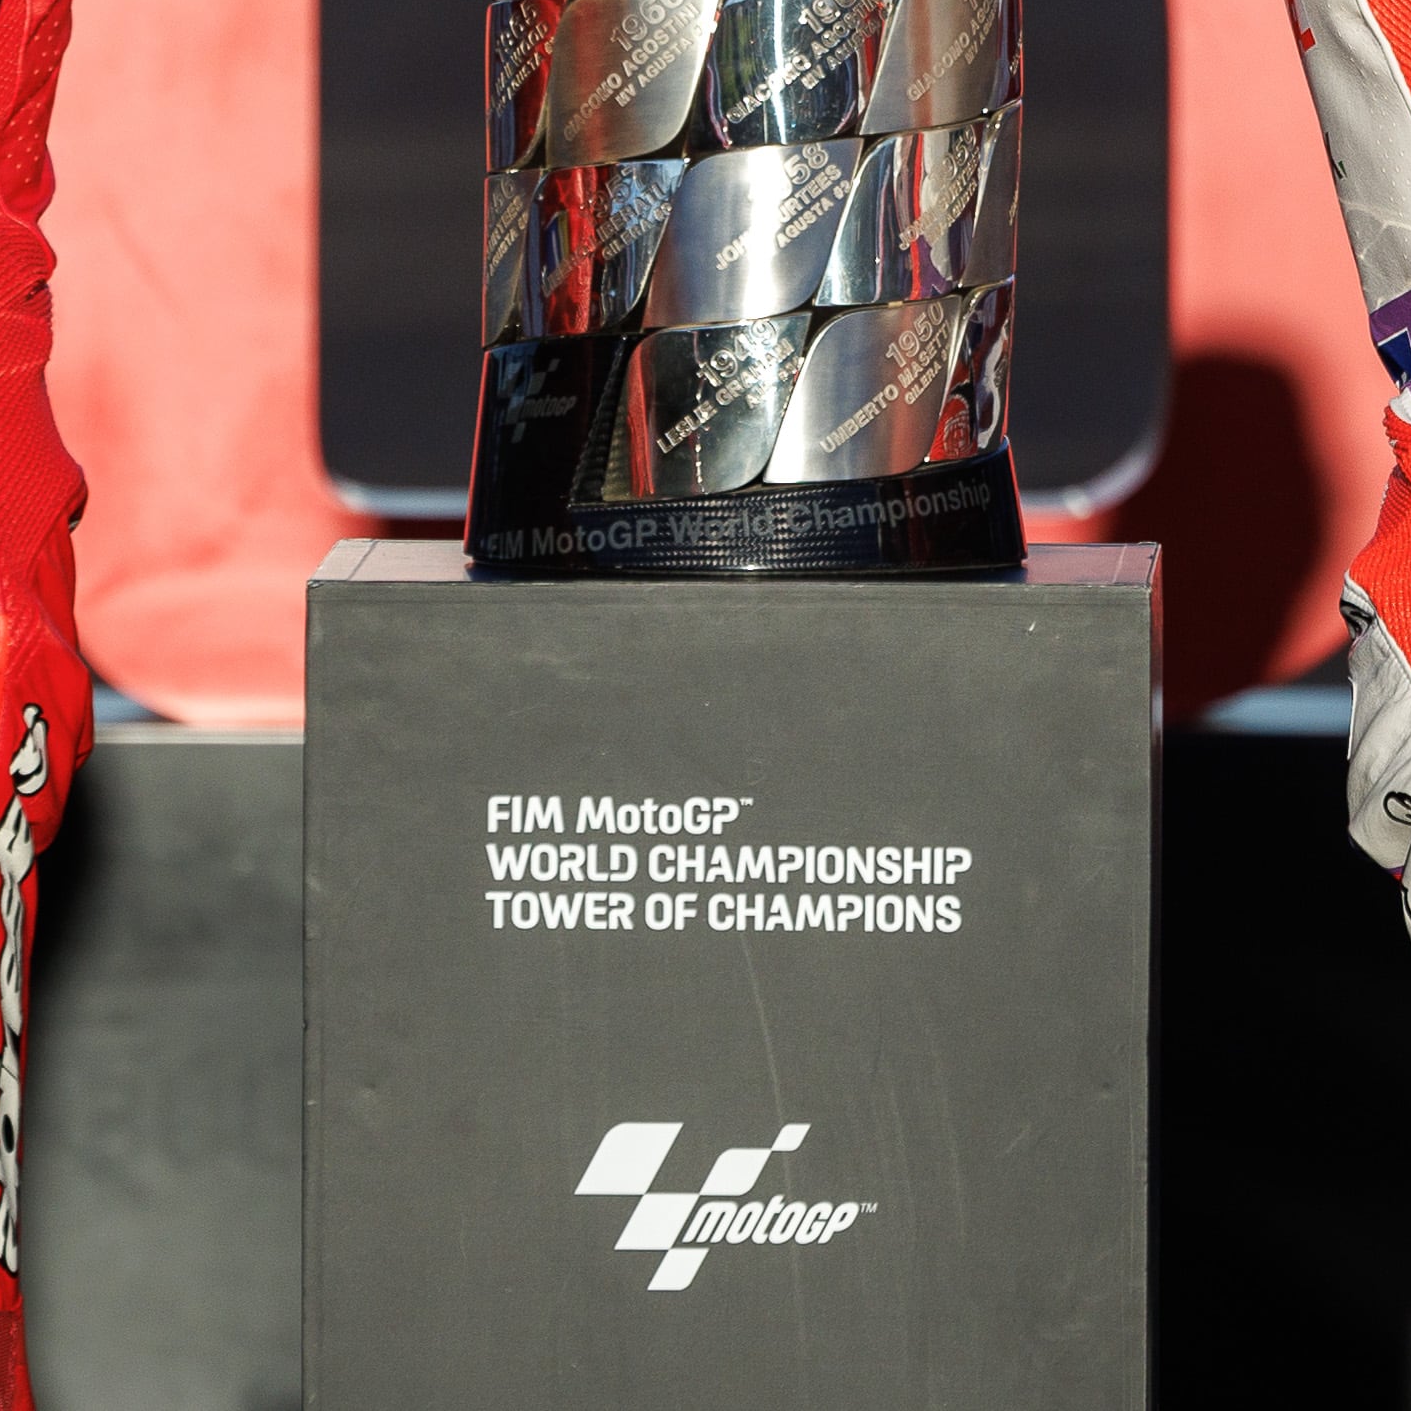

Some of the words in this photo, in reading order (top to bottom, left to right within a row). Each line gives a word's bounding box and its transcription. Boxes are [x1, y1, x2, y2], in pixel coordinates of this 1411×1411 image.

[563, 72, 624, 142] GIACOMO
[621, 1, 701, 77] AGOSTINI
[614, 85, 638, 109] MV
[637, 36, 696, 88] AGUSTA
[905, 31, 970, 102] GIACOMO
[776, 196, 835, 249] AGUSTA
[696, 319, 777, 387] 1949
[886, 301, 946, 369] 1950
[819, 385, 899, 454] UMBERTO
[898, 319, 952, 389] MASETTI
[904, 361, 942, 406] GILERA
[656, 399, 719, 455] LESLIE
[487, 529, 524, 561] FIM
[532, 519, 657, 557] MotoGP
[667, 505, 777, 547] World
[786, 479, 991, 536] Championship
[485, 796, 565, 834] FIM
[485, 843, 639, 883] WORLD
[647, 845, 973, 886] CHAMPIONSHIP
[485, 892, 635, 931] TOWER
[644, 892, 698, 931] OF
[707, 893, 963, 933] CHAMPIONS
